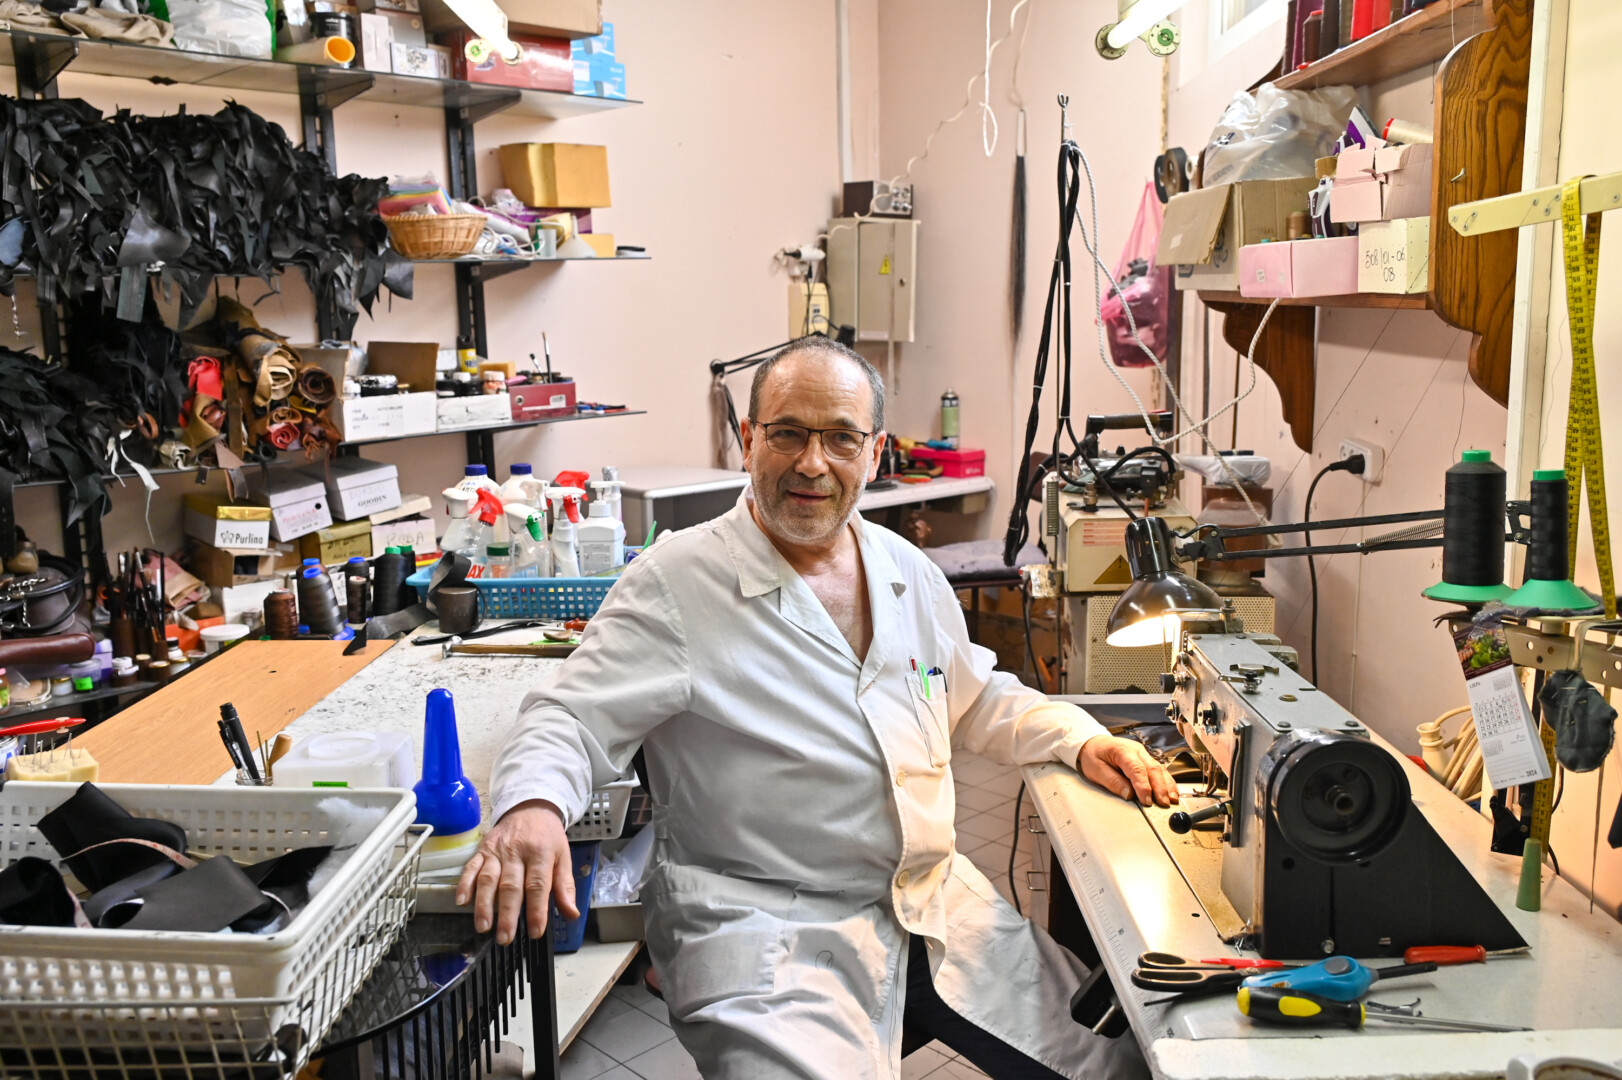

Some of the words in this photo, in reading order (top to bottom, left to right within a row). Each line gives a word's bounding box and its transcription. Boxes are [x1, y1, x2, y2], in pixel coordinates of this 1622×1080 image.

[1383, 266, 1396, 282] 08
[235, 532, 264, 544] Purlina
[466, 564, 486, 578] AX
